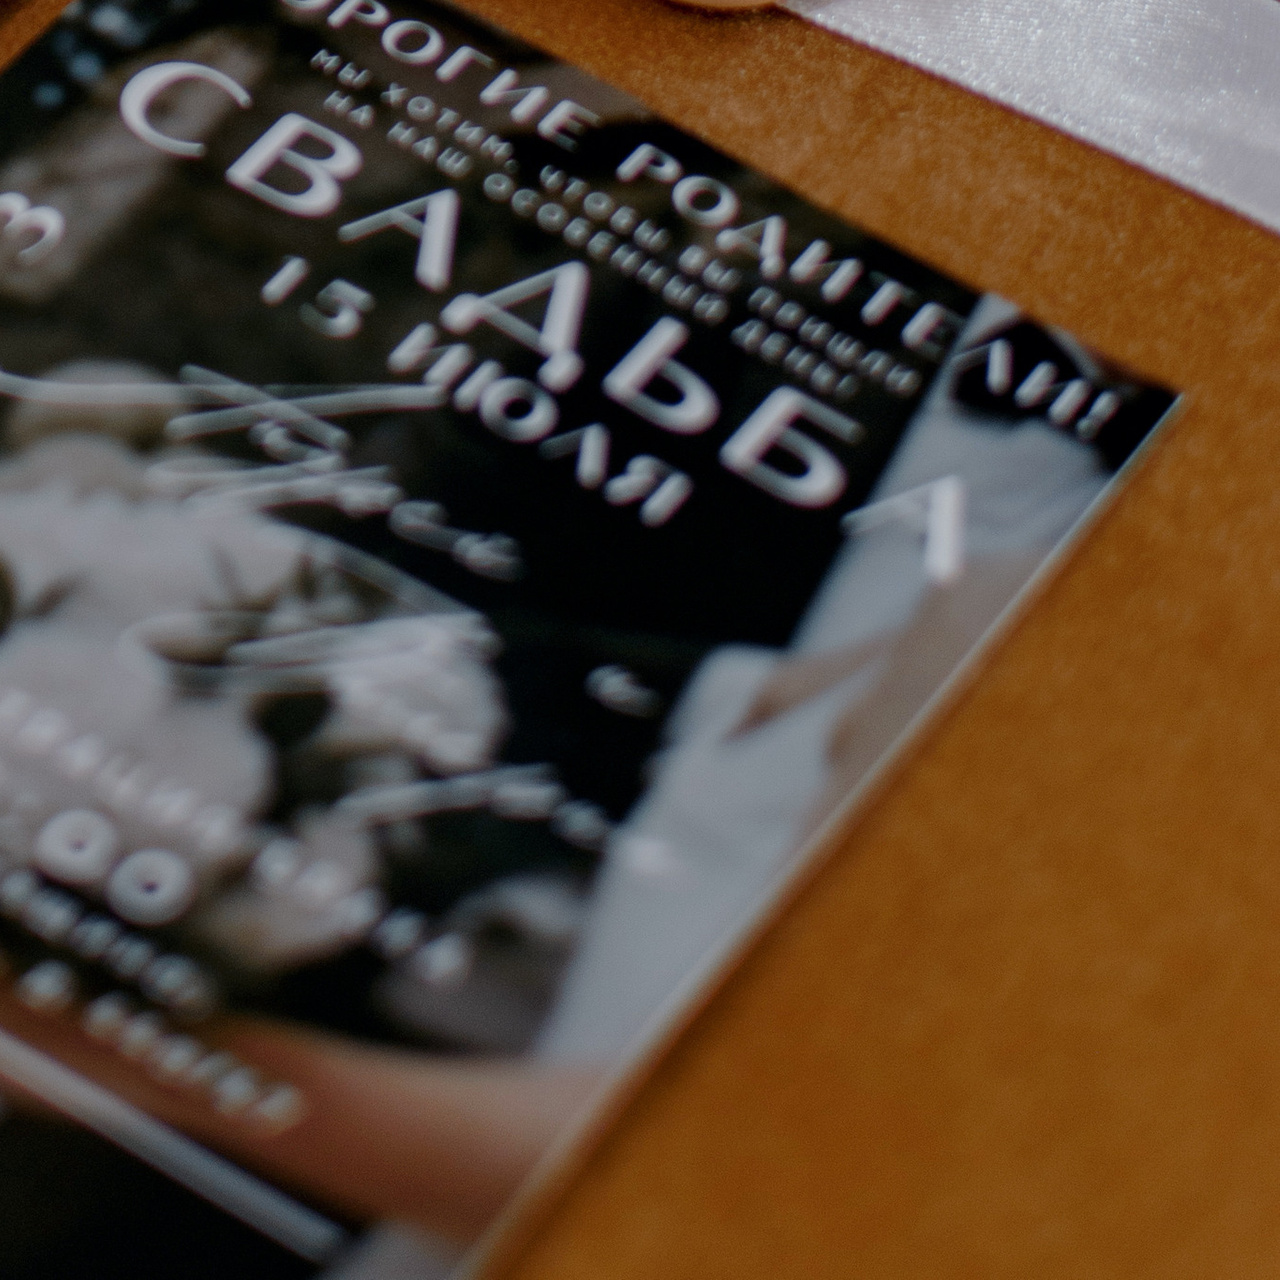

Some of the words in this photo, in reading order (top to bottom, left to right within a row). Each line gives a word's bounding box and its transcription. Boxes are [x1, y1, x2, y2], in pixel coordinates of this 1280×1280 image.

[310, 48, 372, 91] МЫ
[539, 164, 672, 254] ЧТОБЫ
[323, 90, 375, 130] НА
[387, 120, 473, 180] НАШ
[119, 61, 963, 582] СВАДЬБА
[261, 254, 377, 340] 15
[387, 321, 694, 528] ИЮЛЯ
[616, 142, 1120, 438] РОДИТЕЛИ!
